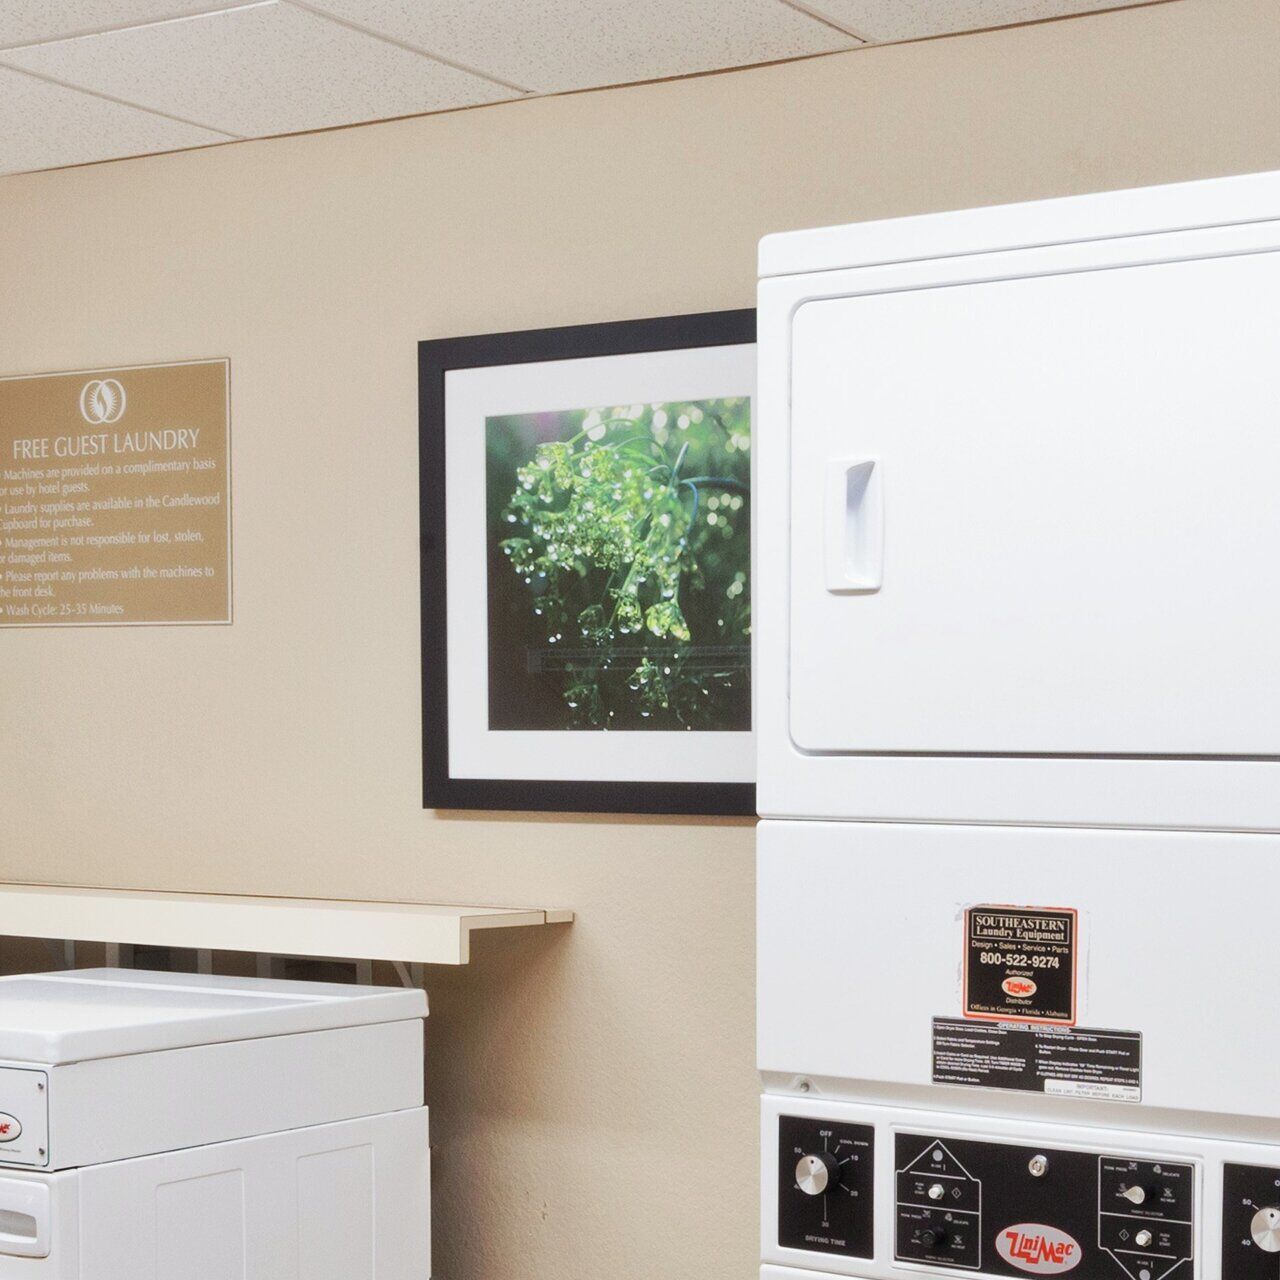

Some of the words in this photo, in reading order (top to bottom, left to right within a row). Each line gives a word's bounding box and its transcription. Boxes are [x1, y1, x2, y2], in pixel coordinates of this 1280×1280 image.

[13, 438, 49, 460] FREE
[54, 434, 108, 457] GUEST
[114, 428, 200, 453] LAUNDRY
[4, 468, 44, 480] Machines
[46, 469, 60, 478] are
[61, 463, 100, 480] provided
[101, 465, 113, 475] on
[115, 466, 121, 474] a
[123, 460, 191, 476] complimentary
[193, 458, 216, 470] basis
[9, 486, 24, 496] use
[26, 484, 35, 498] by
[39, 481, 60, 494] hotel
[62, 482, 90, 496] guests.
[5, 501, 37, 514] Laundry
[40, 501, 74, 515] supplies
[77, 502, 90, 511] are
[92, 496, 133, 509] available
[135, 496, 143, 508] in
[145, 496, 160, 507] the
[162, 491, 220, 507] Candlewood
[40, 517, 50, 528] for
[53, 515, 95, 531] purchase.
[5, 537, 59, 550] Management
[61, 535, 68, 545] is
[70, 535, 84, 545] not
[86, 531, 136, 548] responsible
[138, 530, 151, 543] for
[175, 529, 204, 543] stolen,
[8, 550, 46, 566] damaged
[48, 551, 73, 562] items.
[5, 570, 32, 581] Please
[34, 571, 59, 584] report
[61, 571, 75, 583] any
[78, 567, 118, 583] problems
[120, 566, 141, 579] with
[143, 566, 158, 578] the
[160, 565, 203, 577] machines
[204, 567, 215, 577] to
[13, 585, 32, 597] front
[5, 604, 30, 616] Wash
[60, 603, 87, 616] 25-35
[89, 604, 124, 615] Minutes
[976, 916, 1065, 930] SOUTHEASTERN
[977, 926, 1013, 939] Laundry
[1017, 929, 1064, 941] Equipment
[972, 940, 993, 949] Design
[999, 942, 1016, 950] Sales
[1023, 944, 1046, 952] Service
[980, 952, 1059, 969] 800-522-9274
[794, 1146, 802, 1154] 50
[1242, 1198, 1252, 1206] 50
[805, 1234, 829, 1244] DRYING
[830, 1238, 846, 1246] TIME
[1006, 1231, 1074, 1265] UniMac
